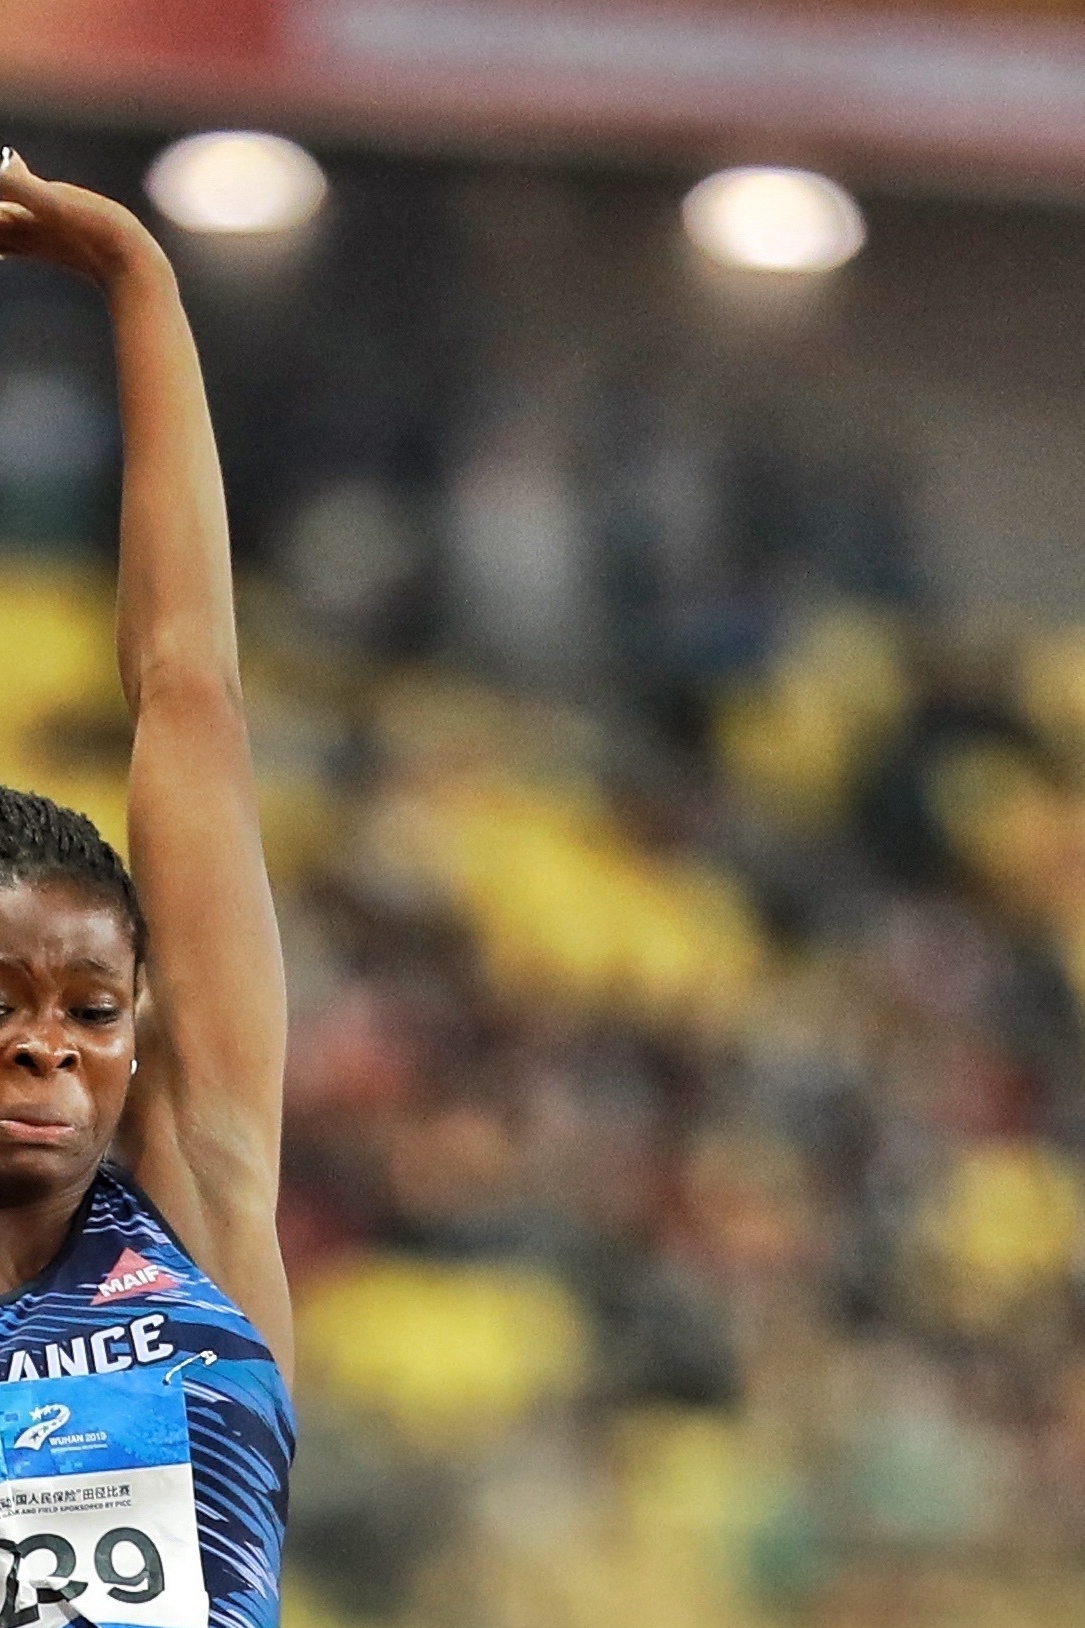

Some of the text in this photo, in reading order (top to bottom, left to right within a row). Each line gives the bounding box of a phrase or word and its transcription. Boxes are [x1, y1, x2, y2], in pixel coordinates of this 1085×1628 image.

[98, 1263, 160, 1298] MAIF
[48, 1430, 108, 1446] WUHAN 2019
[37, 1505, 59, 1514] FIELD
[60, 1502, 104, 1513] SPONSORED
[104, 1501, 115, 1509] BY
